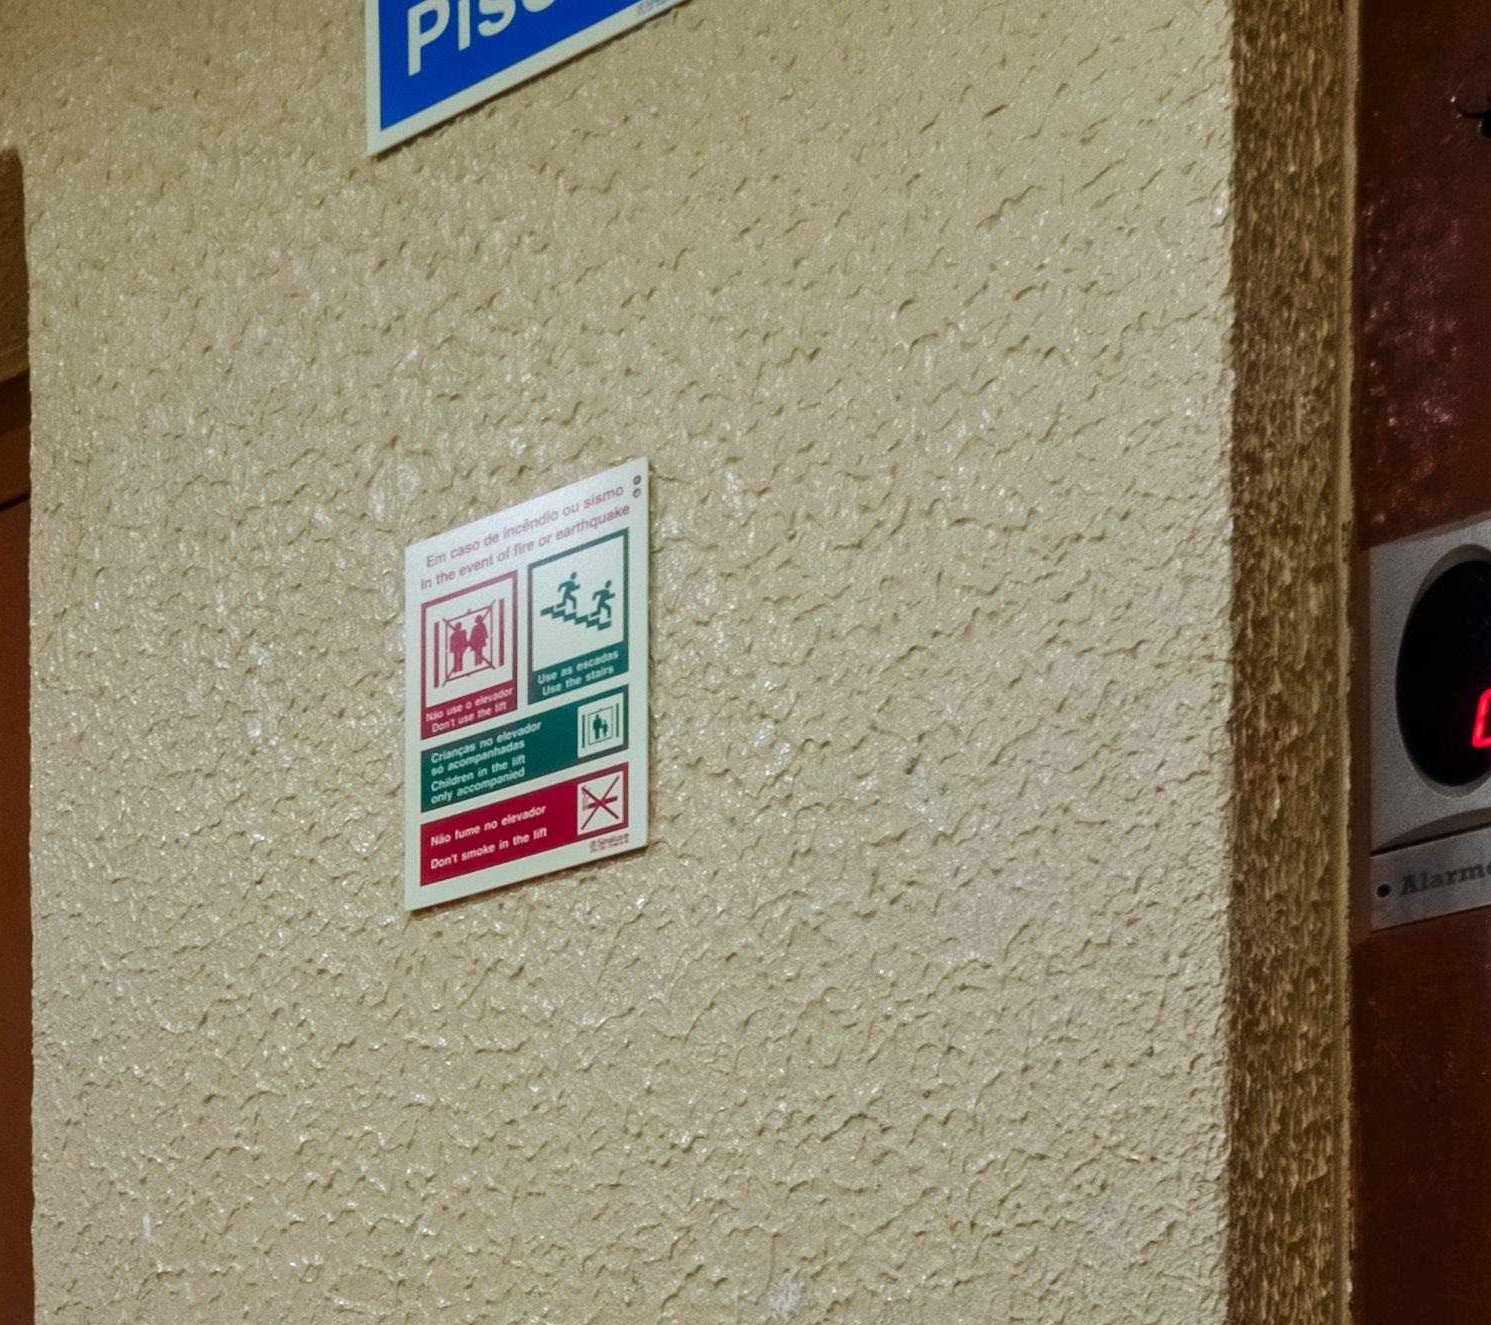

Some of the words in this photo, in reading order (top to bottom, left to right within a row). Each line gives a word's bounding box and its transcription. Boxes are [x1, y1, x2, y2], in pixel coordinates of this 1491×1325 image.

[408, 0, 556, 76] PIS
[427, 553, 446, 568] Em
[451, 540, 480, 560] caso
[484, 533, 499, 546] de
[503, 510, 558, 539] incêndio
[563, 504, 579, 517] ou
[584, 486, 624, 509] sismo
[421, 577, 432, 590] In
[437, 568, 455, 586] the
[459, 554, 494, 576] event
[498, 547, 509, 561] of
[514, 539, 534, 556] fire
[538, 537, 551, 547] or
[556, 504, 630, 540] earthquake
[538, 672, 557, 684] Use
[561, 666, 573, 677] as
[576, 650, 619, 671] escadas
[542, 683, 562, 695] Use
[566, 677, 581, 688] the
[585, 665, 614, 681] stairs
[426, 708, 444, 721] Não
[447, 704, 462, 715] use
[475, 687, 514, 706] elevador
[432, 719, 455, 733] Don't
[458, 714, 474, 725] use
[477, 708, 492, 720] the
[495, 701, 507, 715] lift
[431, 742, 476, 763] Crianças
[480, 737, 494, 748] no
[497, 721, 542, 743] elevador
[431, 764, 444, 776] só
[447, 740, 525, 771] acompanhadas
[431, 773, 474, 792] Children
[478, 765, 488, 776] in
[492, 757, 508, 772] the
[512, 754, 525, 766] lift
[431, 789, 453, 804] only
[457, 767, 525, 797] accompanied
[431, 833, 451, 847] Não
[455, 824, 480, 840] fume
[484, 820, 498, 831] no
[501, 804, 546, 826] elevador
[431, 853, 458, 870] Don't
[461, 844, 495, 862] smoke
[499, 840, 509, 850] in
[513, 832, 530, 846] the
[533, 827, 548, 841] lift
